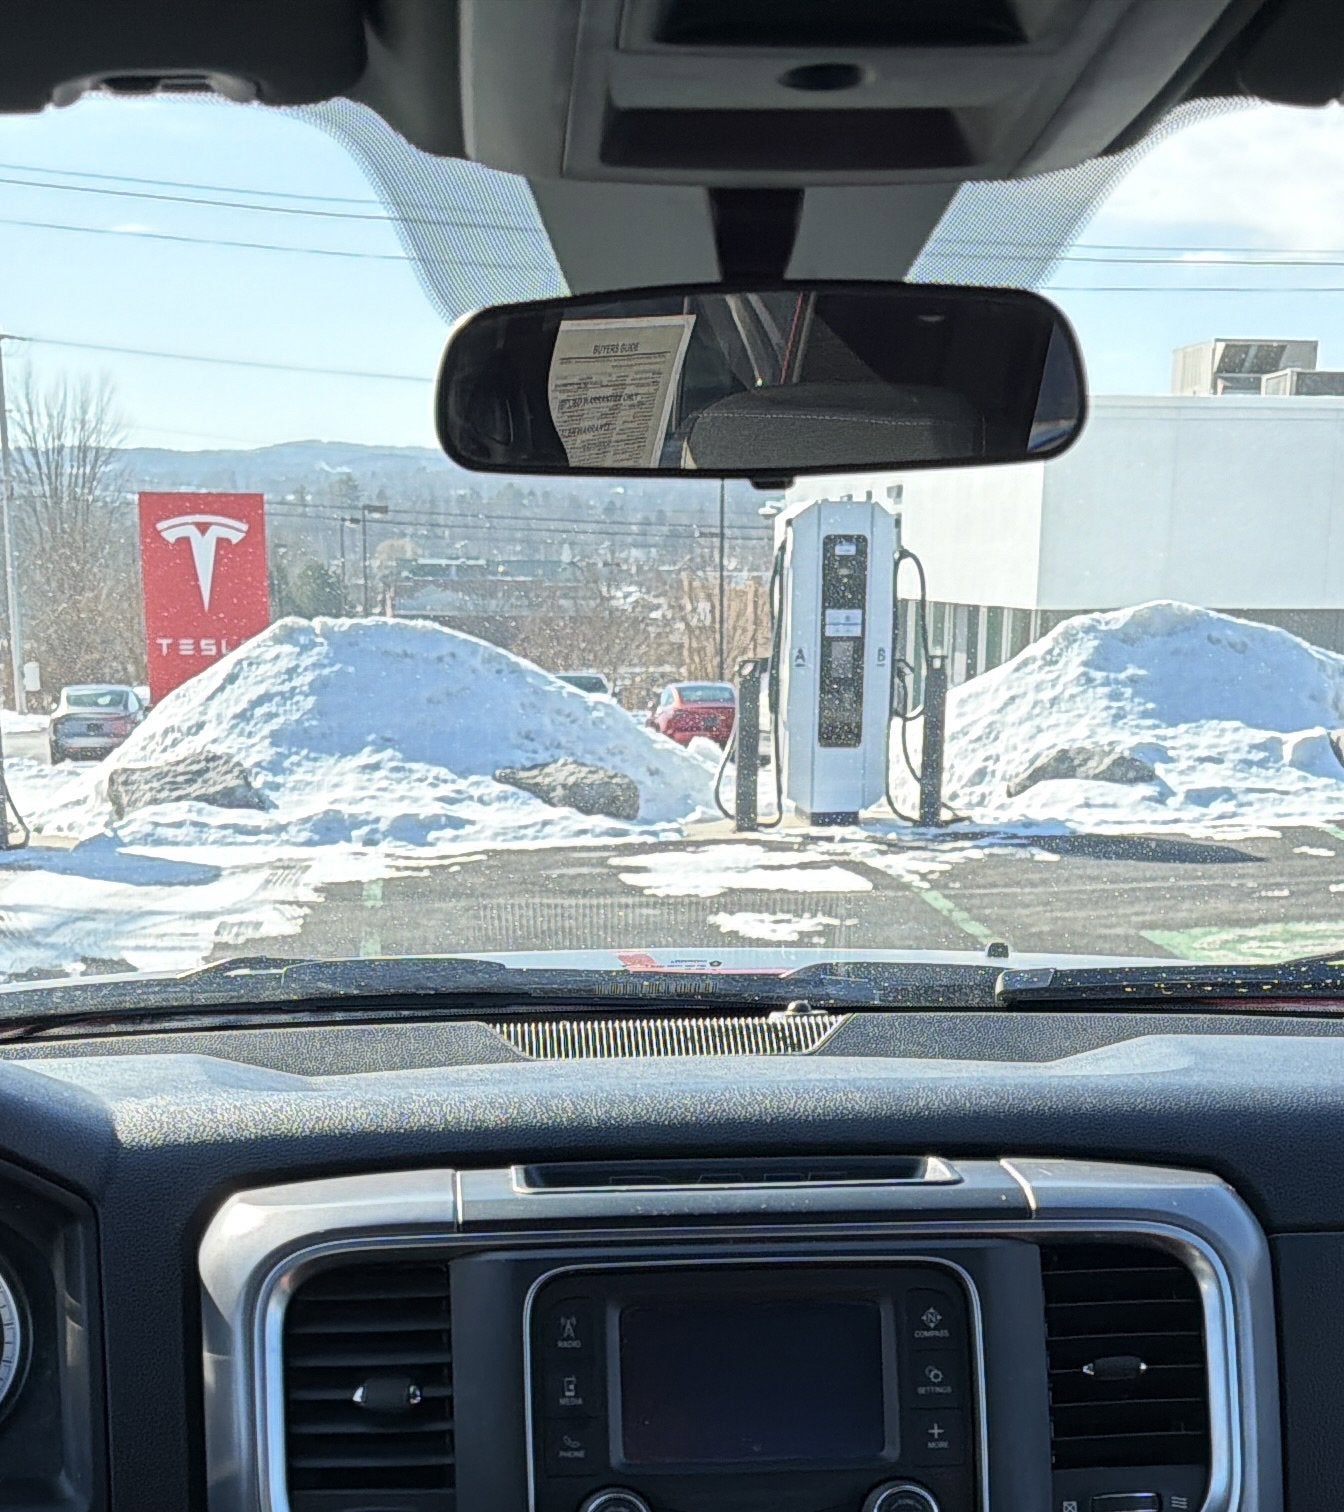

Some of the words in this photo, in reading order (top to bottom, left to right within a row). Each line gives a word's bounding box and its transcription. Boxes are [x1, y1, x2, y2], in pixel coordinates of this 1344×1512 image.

[156, 638, 244, 656] TESL
[794, 647, 806, 662] A
[877, 647, 886, 662] B
